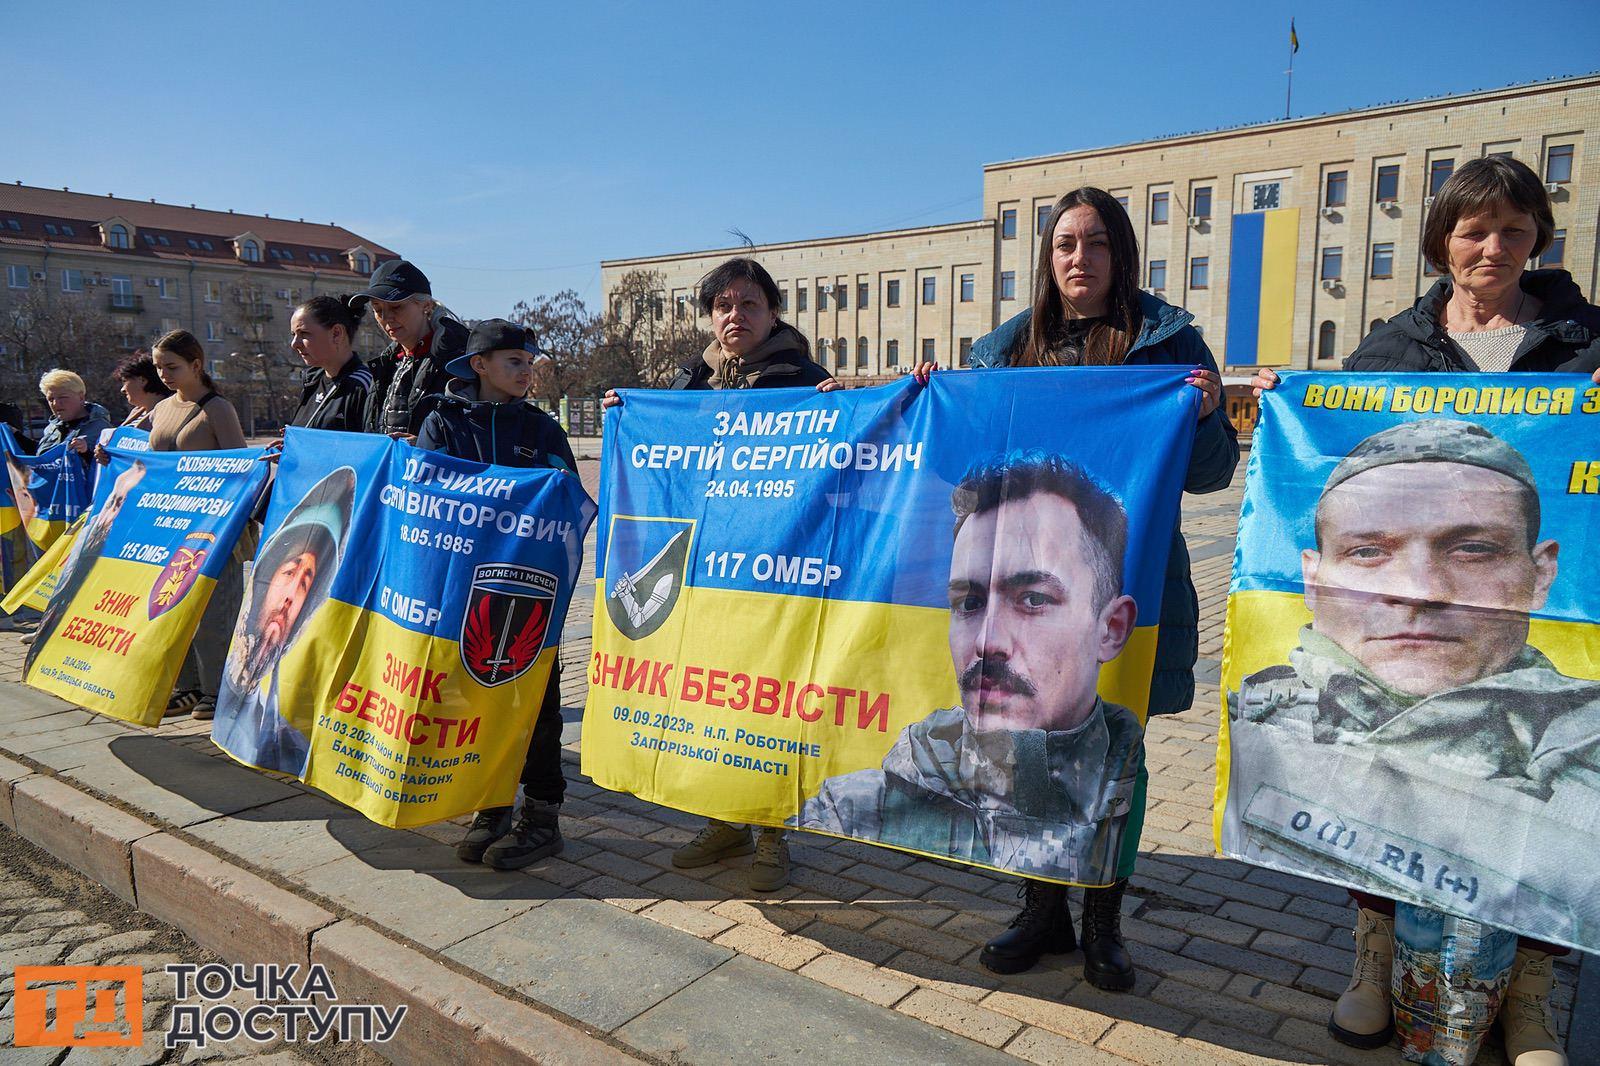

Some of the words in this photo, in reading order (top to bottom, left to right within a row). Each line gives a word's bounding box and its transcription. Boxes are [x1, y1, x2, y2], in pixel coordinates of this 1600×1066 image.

[1302, 384, 1386, 412] ВОНИ
[1392, 385, 1576, 416] БОРОЛИСЯ
[713, 409, 839, 437] ЗАМЯТІН
[176, 456, 254, 474] СКЛЯНІЧЕНКО
[631, 440, 725, 471] СЕРГІЙ
[731, 437, 923, 472] СЕРГІЙОВИЧ
[174, 475, 225, 493] РУСЛАН
[704, 479, 795, 499] 24.04.1995
[406, 491, 571, 543] ВІКТОРОВИЧ
[119, 541, 141, 559] 115
[400, 524, 475, 555] 18.05.1985
[478, 569, 518, 579] ВОГНЕМ
[525, 573, 556, 590] МЕЧЕМ
[704, 550, 746, 579] 117
[94, 589, 140, 618] ЗНИК
[61, 616, 137, 656] БЕЗВІСТИ
[382, 652, 448, 704] ЗНИК
[591, 651, 674, 698] ЗНИК
[681, 665, 891, 734] БЕЗВІСТИ
[334, 681, 482, 749] БЕЗВІСТИ
[1375, 842, 1425, 883] Rh
[1434, 864, 1479, 904] (+)
